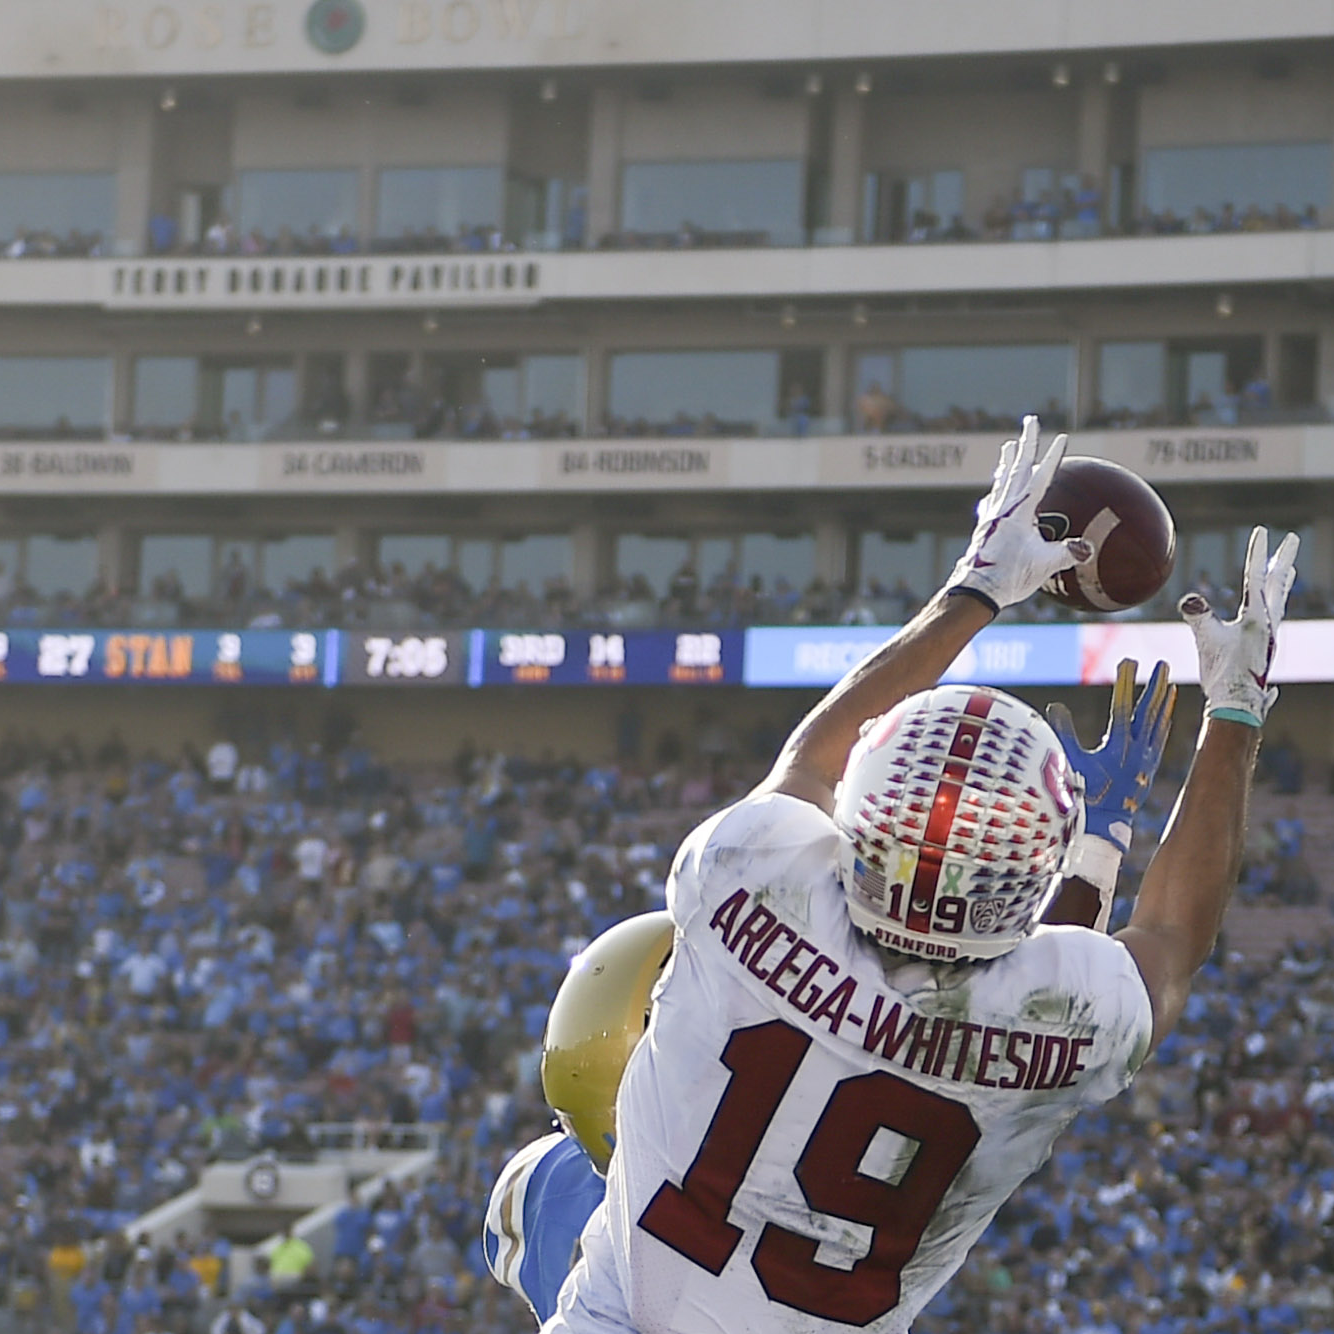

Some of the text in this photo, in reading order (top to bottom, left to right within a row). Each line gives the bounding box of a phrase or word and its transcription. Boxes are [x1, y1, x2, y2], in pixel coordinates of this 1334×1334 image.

[96, 0, 589, 50] ROSE BOWL
[389, 262, 540, 292] PAVILION
[104, 634, 194, 677] STAN
[217, 633, 241, 664] 3
[290, 633, 317, 666] 3
[364, 637, 448, 677] 7:05
[875, 926, 958, 959] STANFORD
[709, 888, 1094, 1091] ARCEGA-WHITESIDE
[637, 1018, 982, 1328] 19
